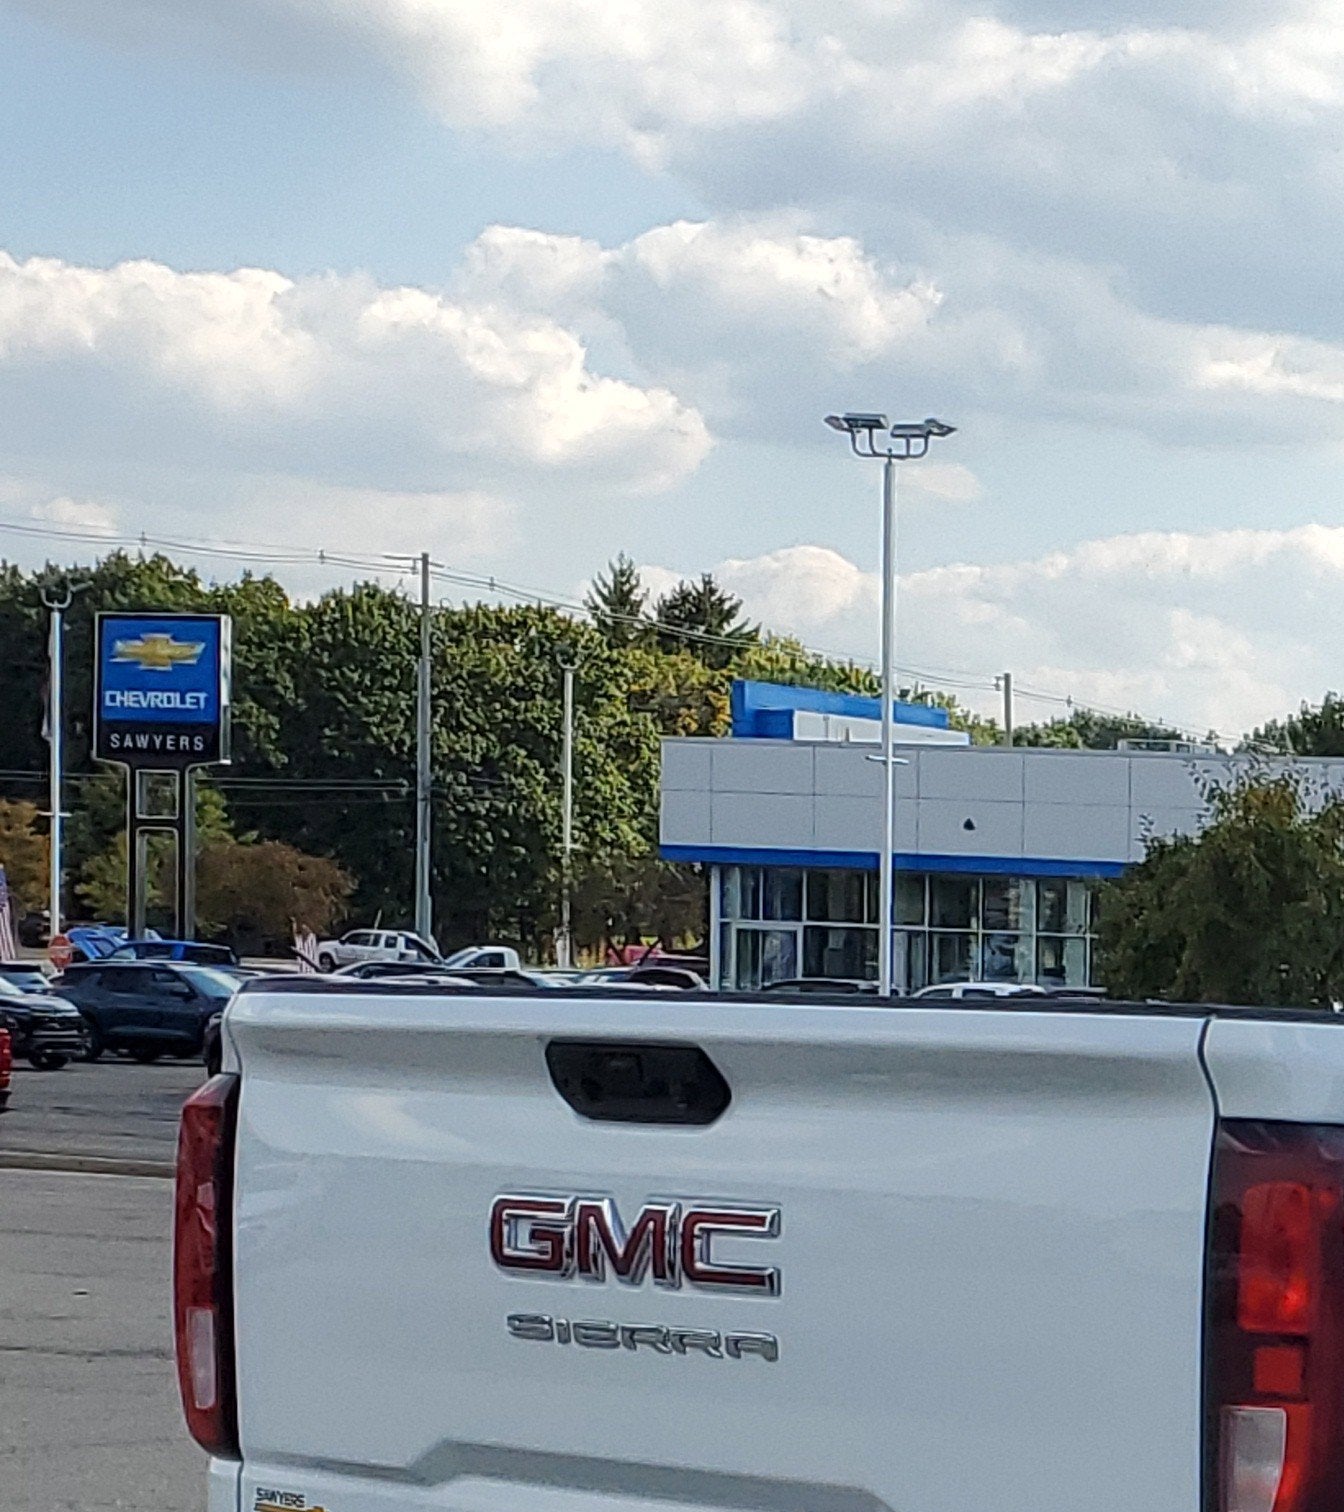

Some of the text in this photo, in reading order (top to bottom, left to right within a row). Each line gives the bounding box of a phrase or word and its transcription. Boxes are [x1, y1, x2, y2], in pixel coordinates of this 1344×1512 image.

[105, 690, 208, 709] CHEVROLET
[110, 733, 204, 751] SAWYERS
[490, 1194, 782, 1297] GMC
[506, 1313, 779, 1362] SIERRA
